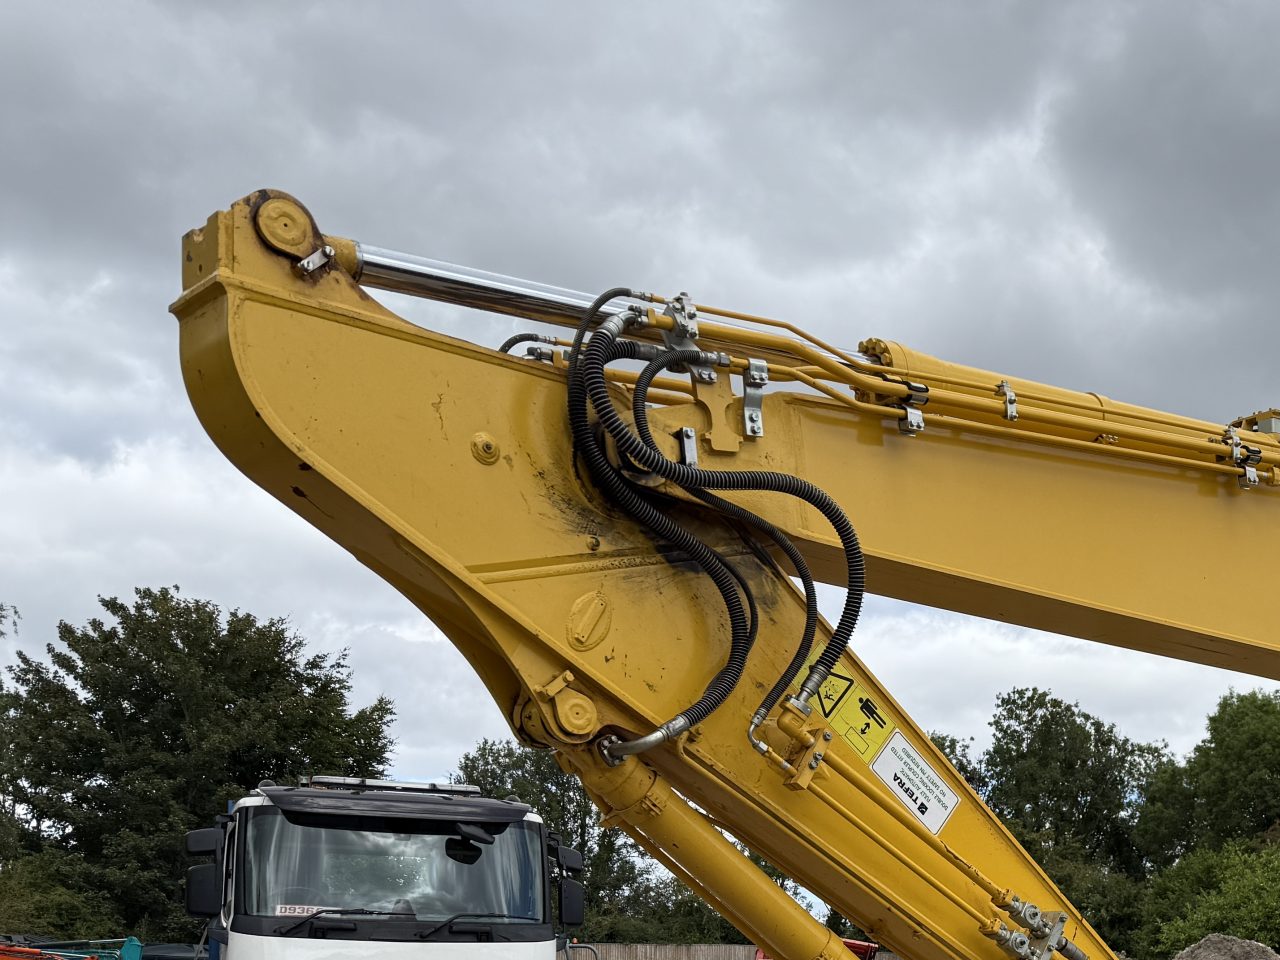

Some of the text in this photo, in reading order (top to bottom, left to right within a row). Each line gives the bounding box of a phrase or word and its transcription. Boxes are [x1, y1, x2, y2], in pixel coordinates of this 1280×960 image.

[901, 747, 920, 769] REQUIRED
[890, 746, 949, 811] DOUBLE LOCKING COUPLER FITTED
[893, 772, 919, 805] TEFRA
[899, 767, 931, 803] FULLY AUTOMATIC
[926, 774, 940, 791] SAFETY
[939, 789, 947, 798] NO
